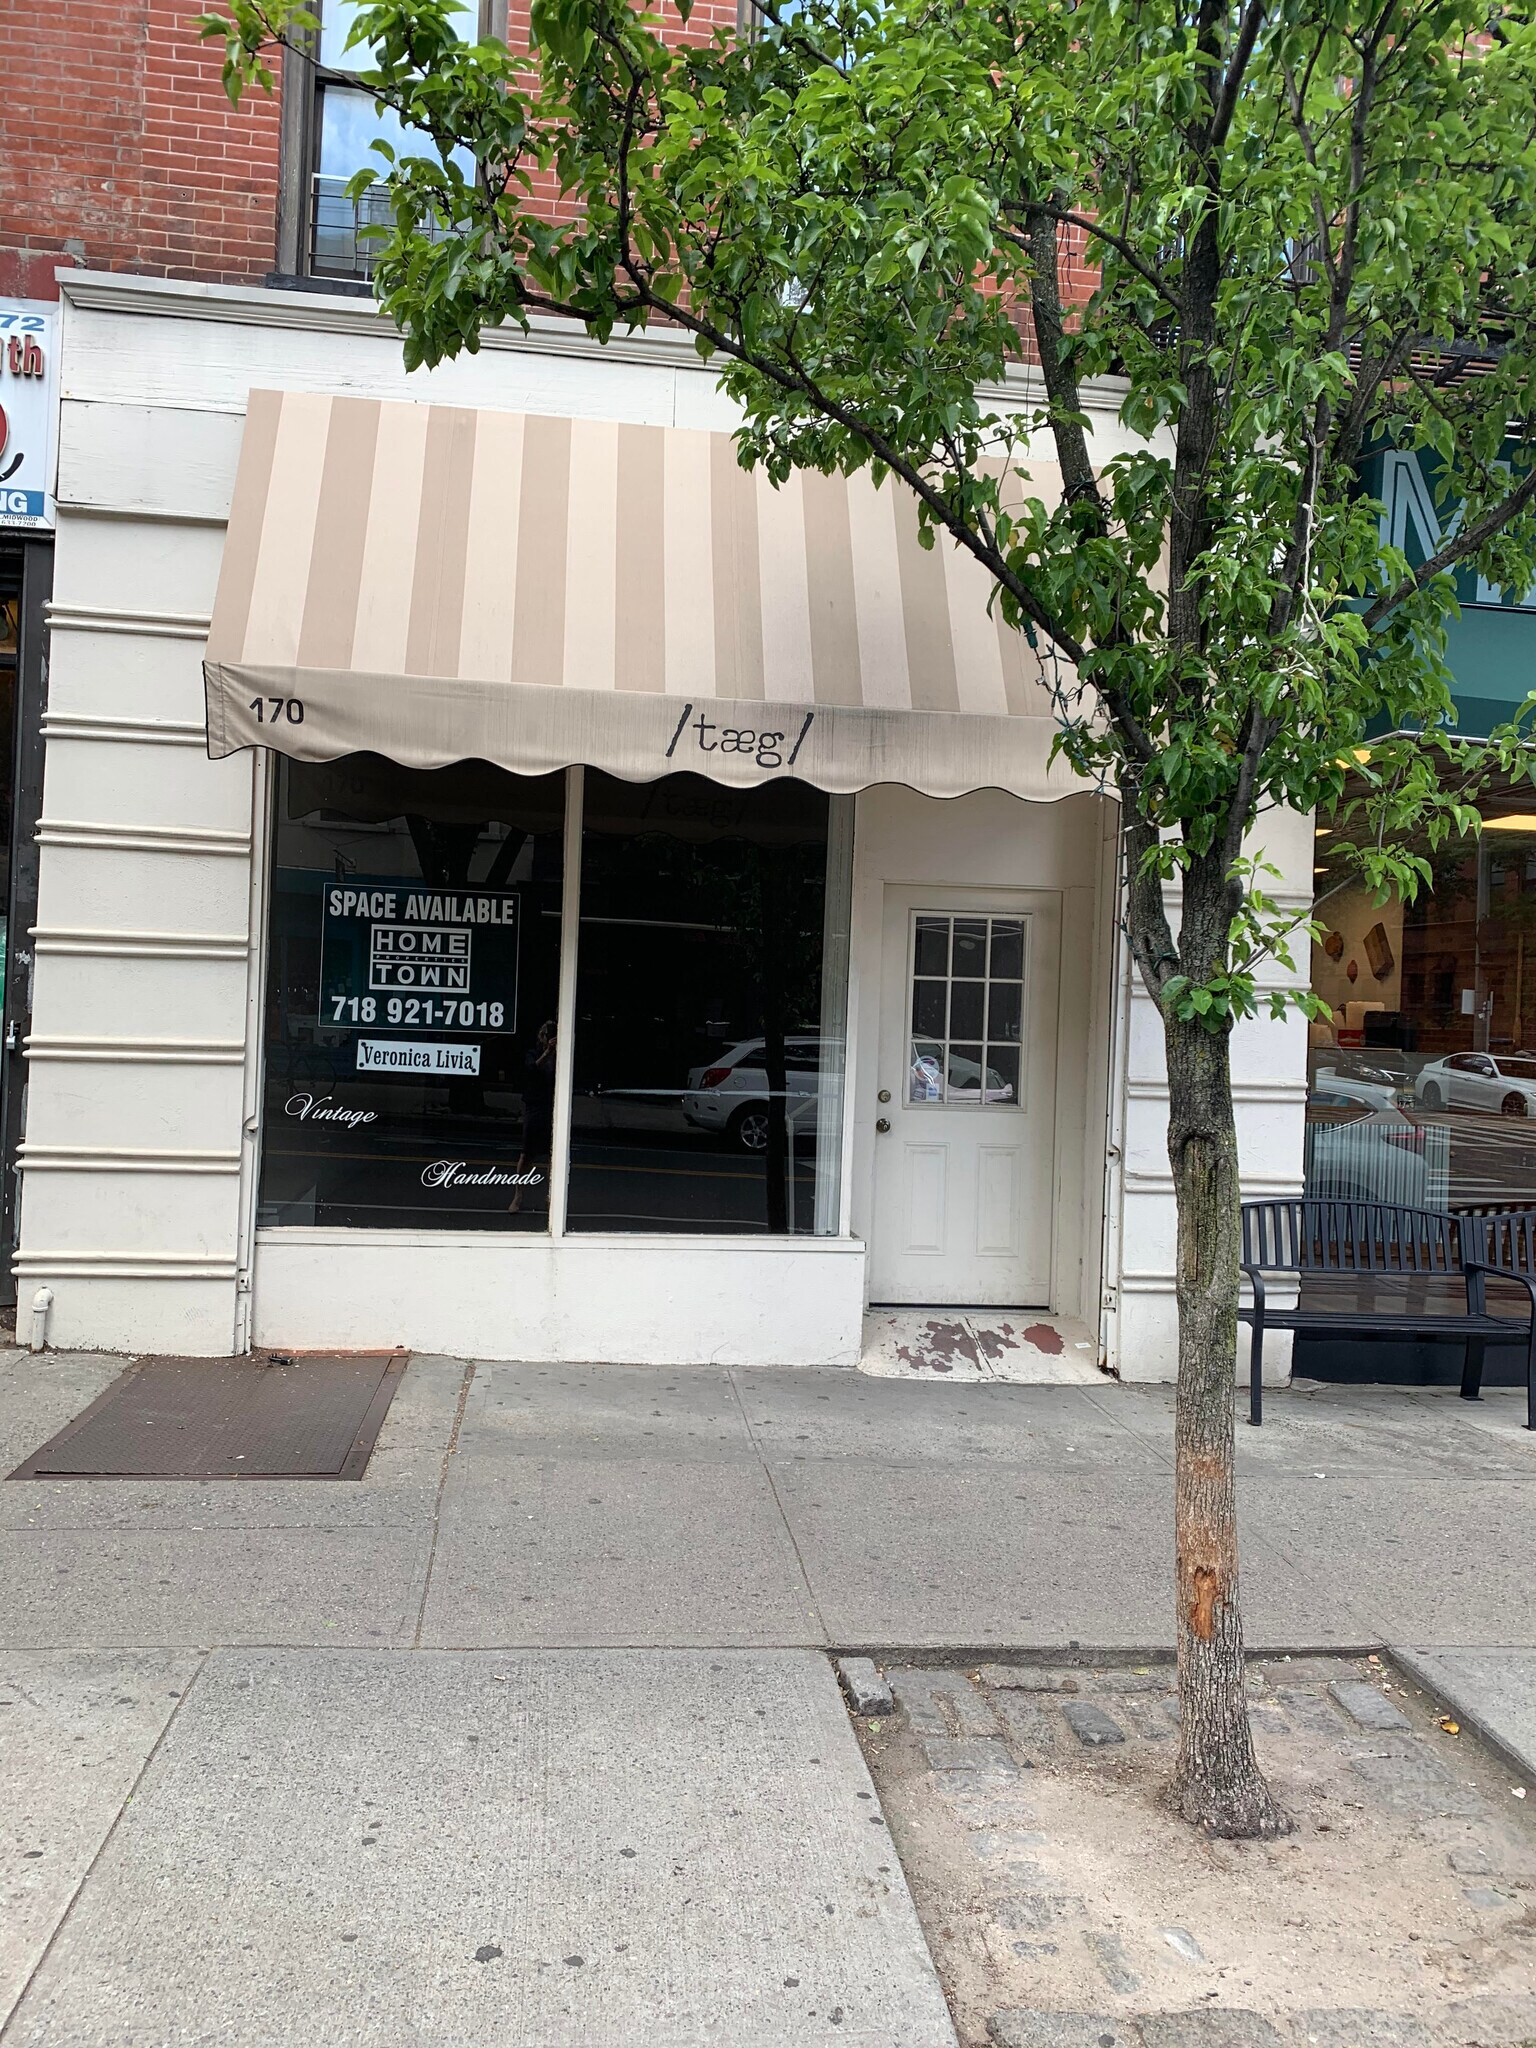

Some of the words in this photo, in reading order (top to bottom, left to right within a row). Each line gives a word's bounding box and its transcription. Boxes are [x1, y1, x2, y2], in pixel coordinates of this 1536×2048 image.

[0, 334, 44, 376] th
[249, 697, 305, 726] 170
[329, 889, 397, 919] SPACE
[404, 894, 514, 925] AVAILABLE
[376, 931, 466, 954] HOME
[376, 954, 466, 964] PROPERTIES
[375, 964, 465, 987] TOWN
[331, 995, 377, 1022] 718
[387, 998, 504, 1028] 921-7018
[363, 1045, 432, 1068] Veronica
[436, 1049, 473, 1070] Livia
[284, 1092, 378, 1129] Vintage
[420, 1159, 545, 1189] Handmade
